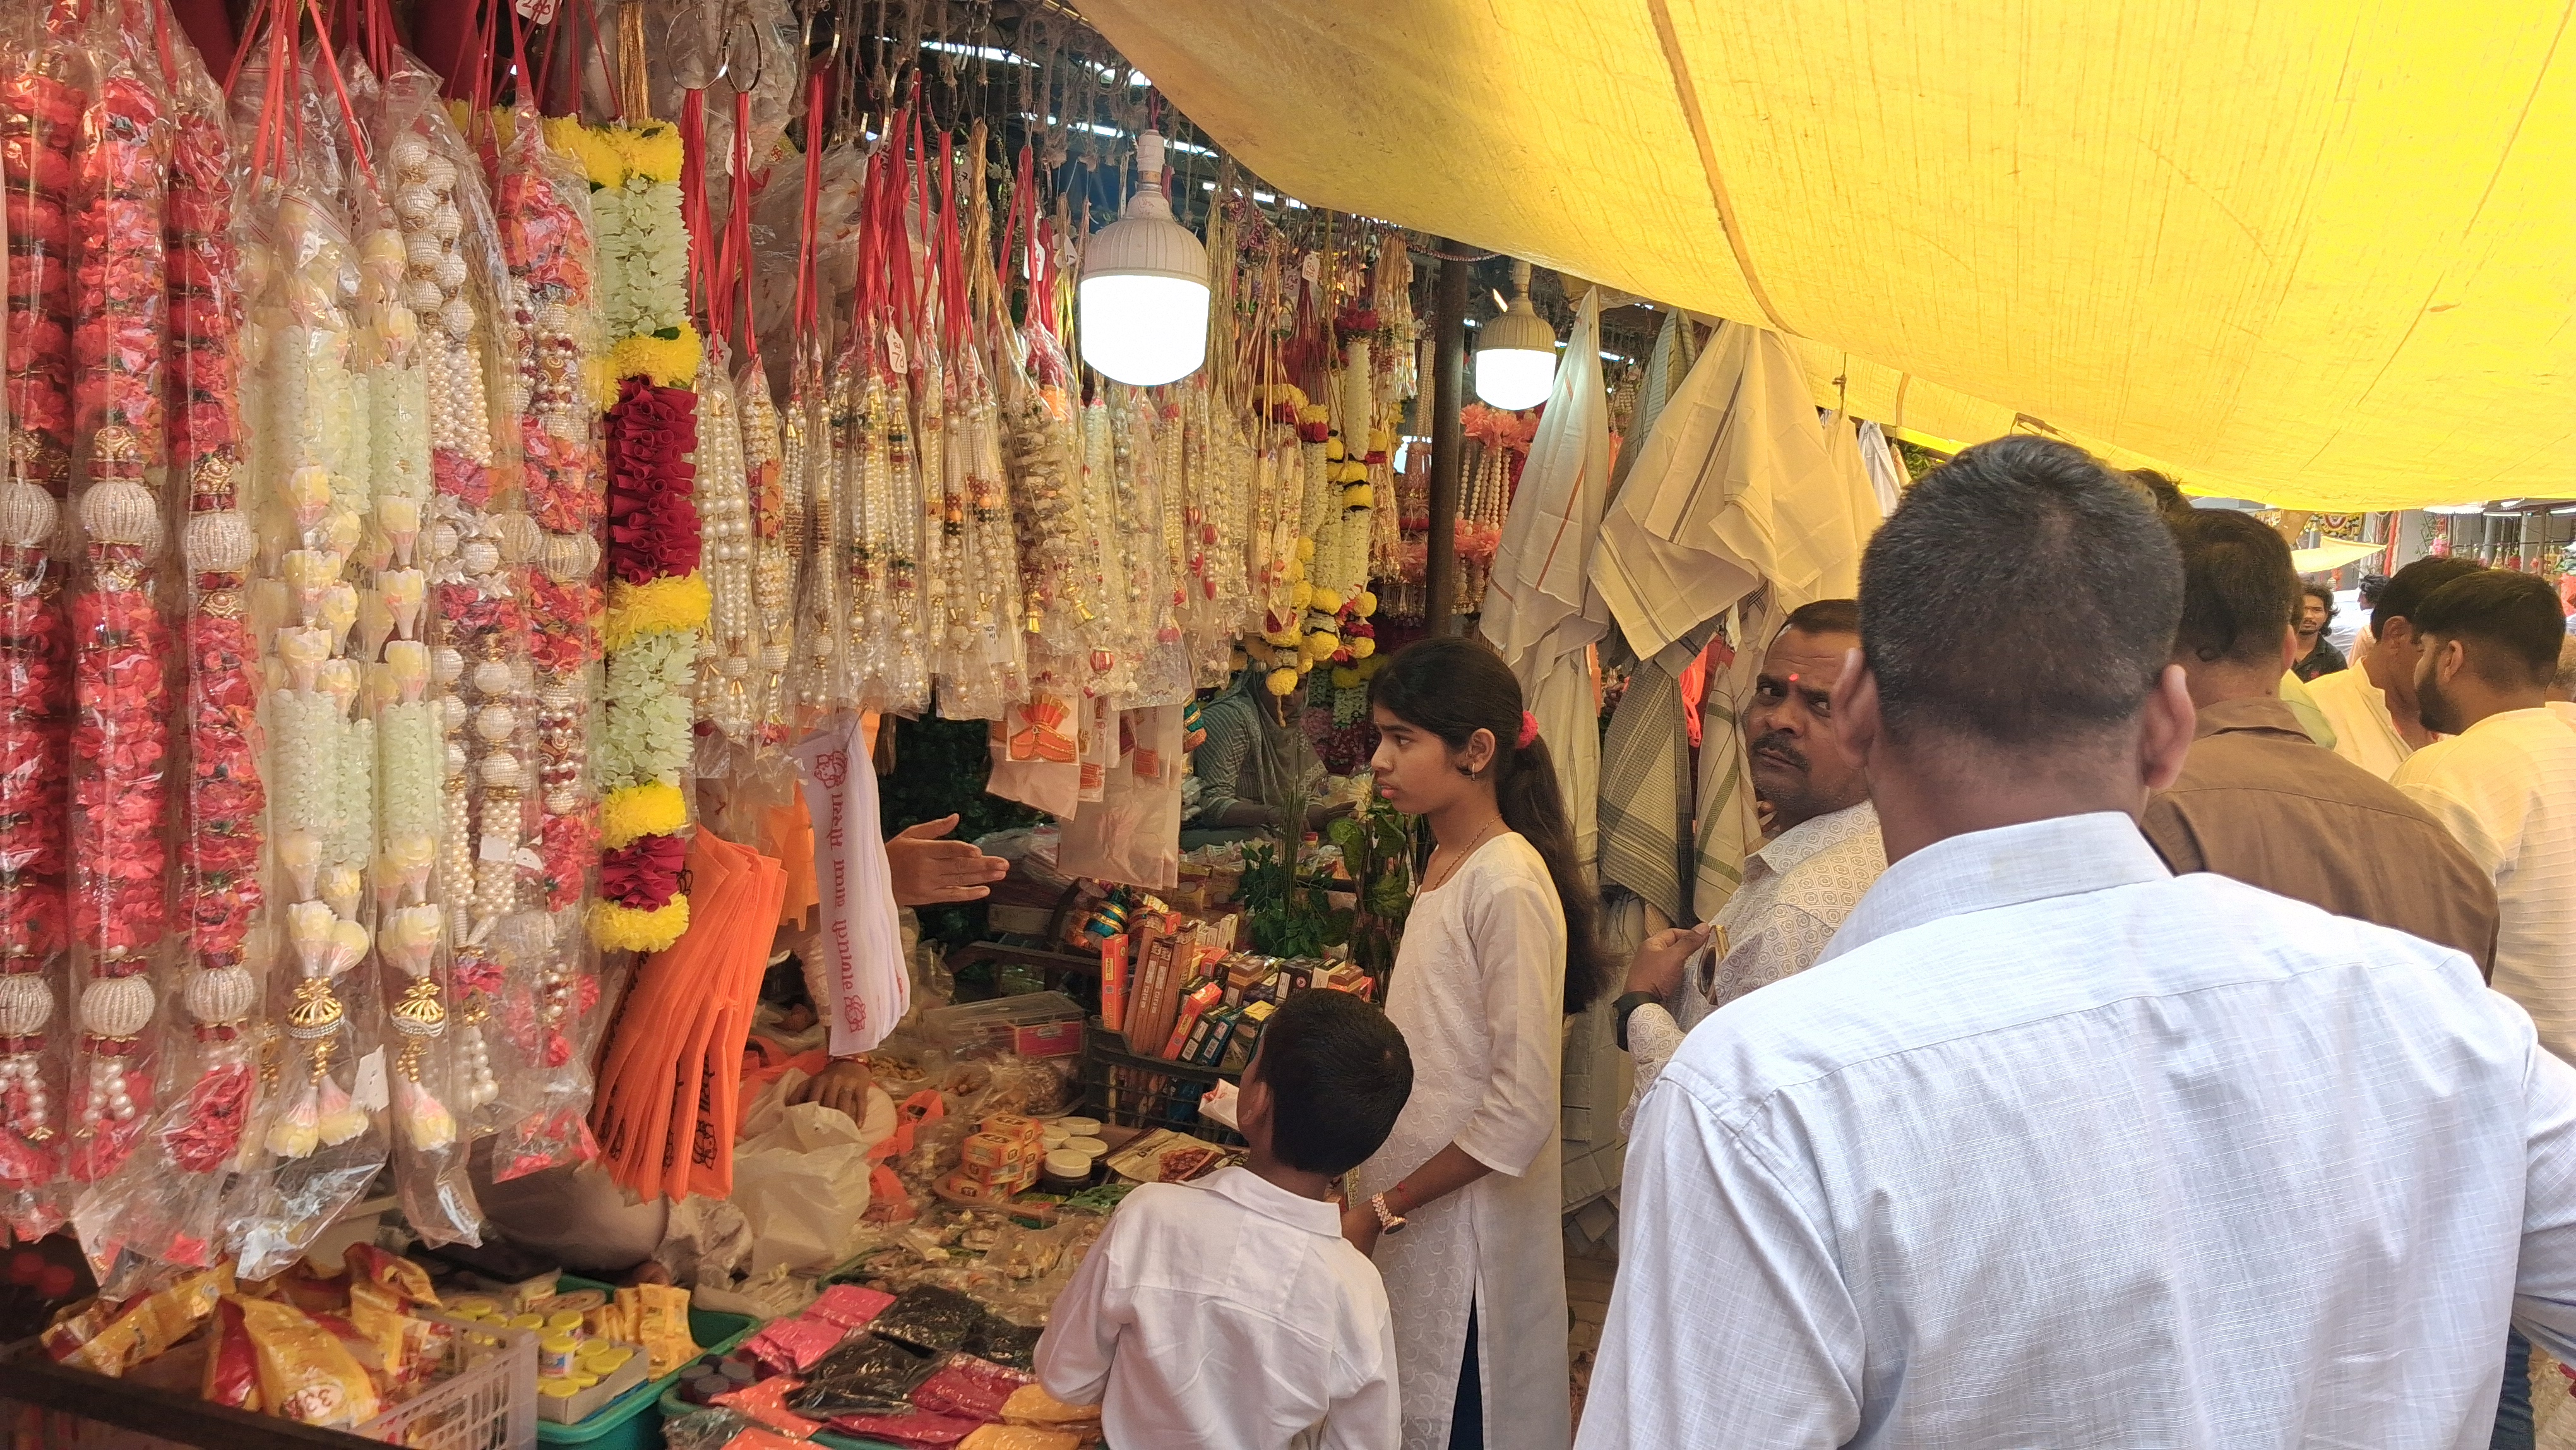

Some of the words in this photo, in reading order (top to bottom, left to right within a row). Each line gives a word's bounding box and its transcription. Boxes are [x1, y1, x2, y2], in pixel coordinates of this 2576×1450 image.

[826, 791, 843, 851] मोरया
[833, 859, 845, 909] बाप्पा
[831, 919, 854, 992] गणपती
